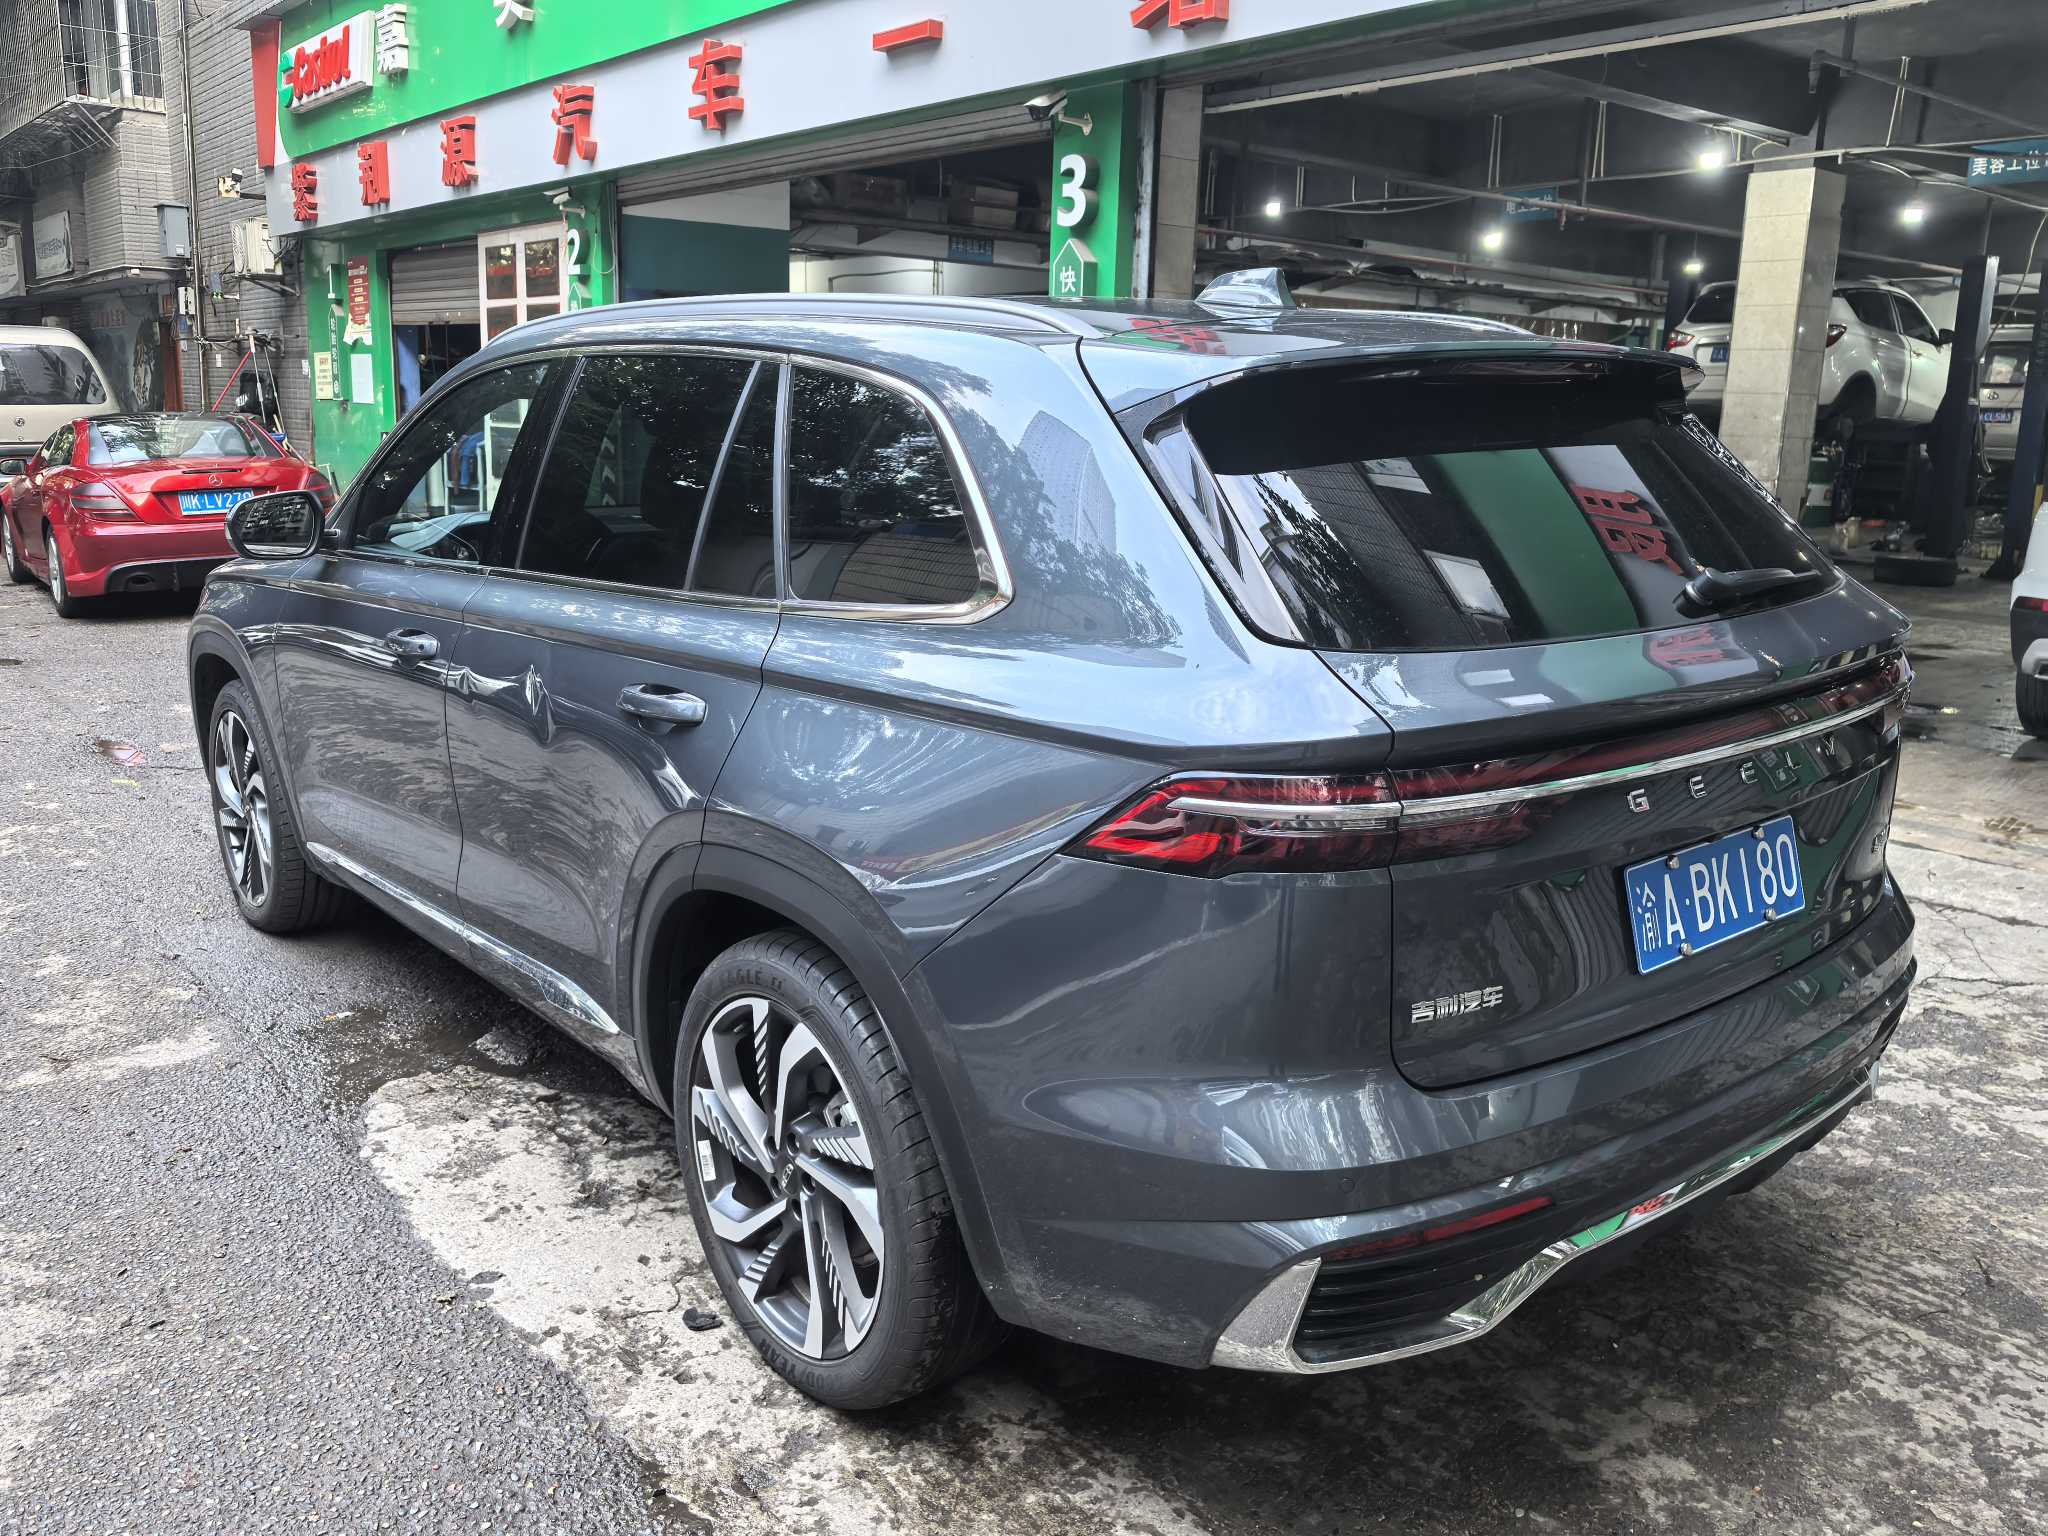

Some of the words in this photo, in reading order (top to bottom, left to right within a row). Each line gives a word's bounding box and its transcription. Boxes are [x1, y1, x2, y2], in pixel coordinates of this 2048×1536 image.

[1971, 149, 2048, 177] 美容工位
[1057, 154, 1087, 227] 3
[567, 228, 581, 274] 2
[1060, 265, 1076, 293] 快
[1627, 736, 1845, 813] GEELY
[1411, 985, 1504, 1023] 吉利汽车
